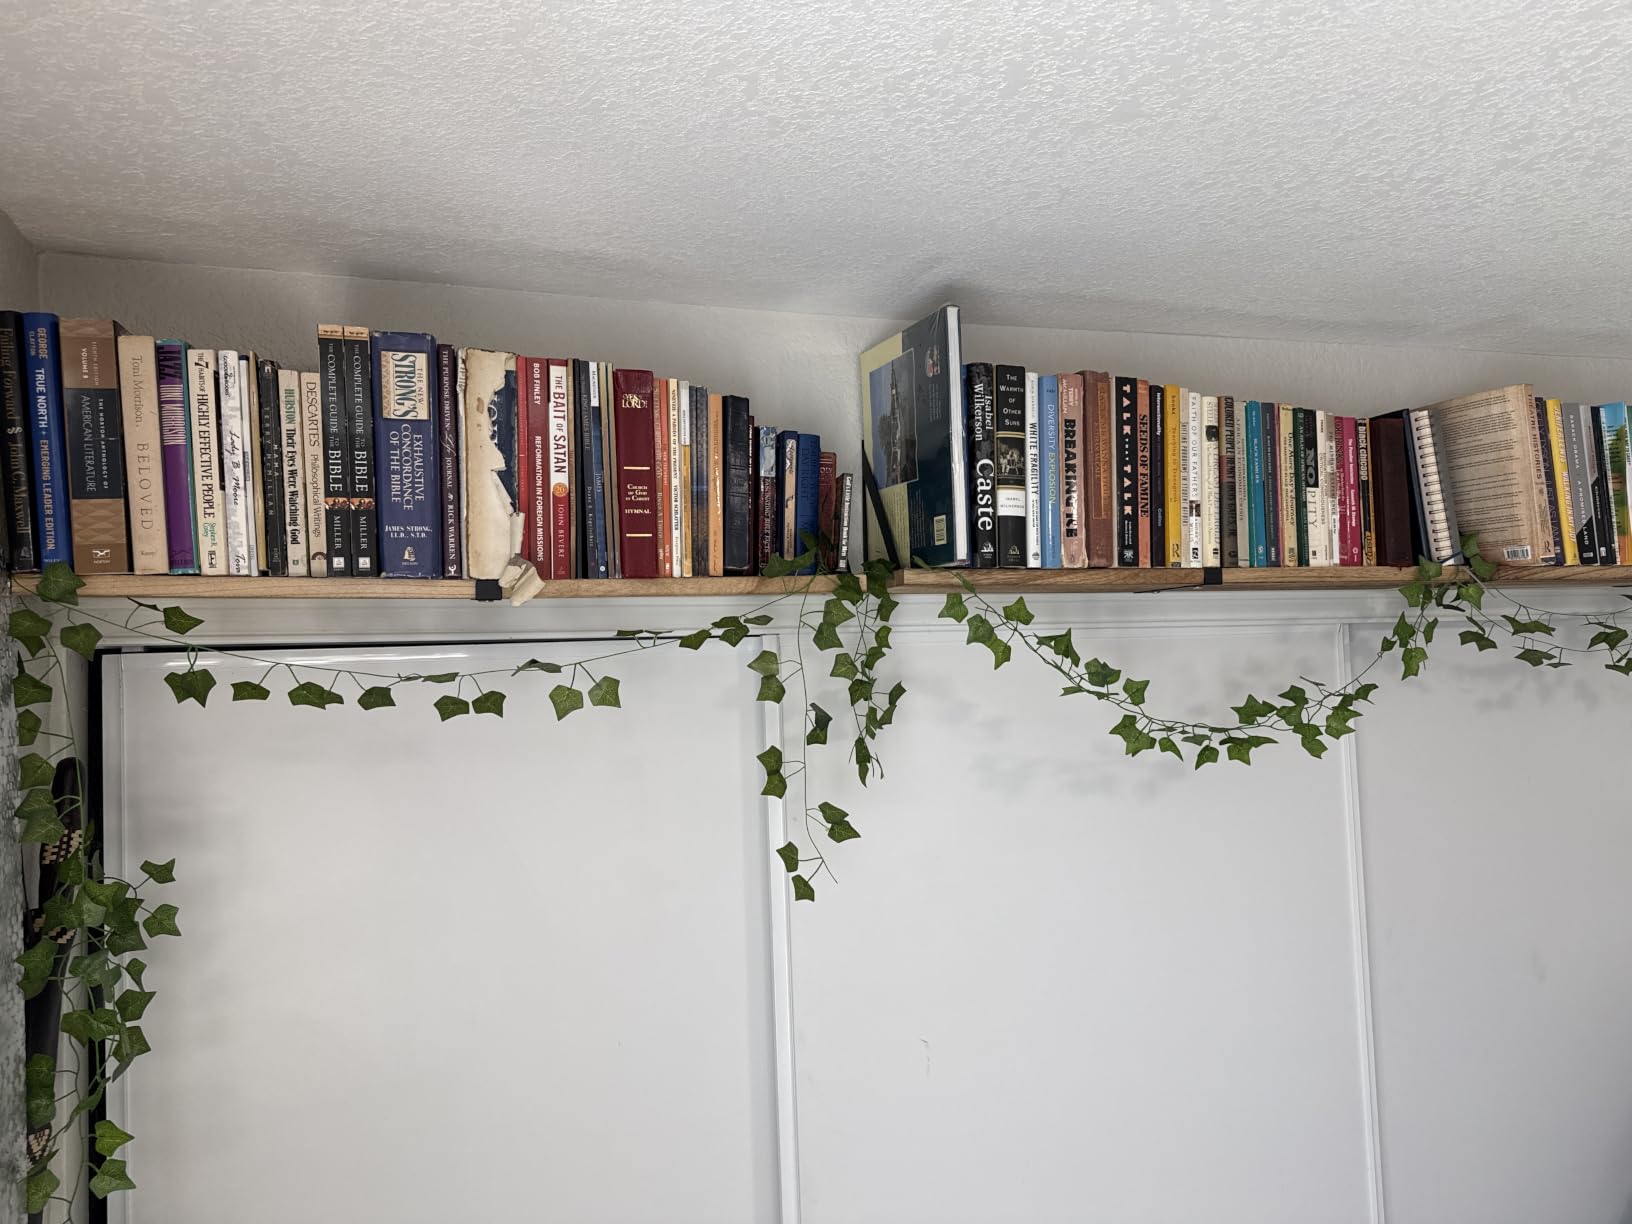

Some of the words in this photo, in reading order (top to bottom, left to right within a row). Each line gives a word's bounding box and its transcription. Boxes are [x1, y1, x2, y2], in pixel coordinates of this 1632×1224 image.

[0, 328, 15, 367] Failing
[37, 327, 48, 359] GEORGE
[35, 368, 46, 393] TRUE
[131, 356, 143, 374] Toni
[194, 361, 209, 369] 7
[198, 367, 206, 384] HABITS
[327, 354, 337, 402] COMPLETE
[353, 355, 363, 403] COMPLETE
[3, 370, 20, 420] Forward
[160, 384, 184, 401] TONI
[391, 353, 418, 418] STRONG'S
[533, 380, 541, 405] FINLEY
[37, 396, 48, 428] NORTH
[80, 395, 93, 441] AMERICAN
[197, 393, 211, 428] HIGHLY
[284, 388, 295, 425] HURSTON
[306, 381, 320, 447] DESCARTES
[328, 405, 338, 433] GUIDE
[355, 406, 365, 434] GUIDE
[553, 392, 566, 421] BAIT
[622, 399, 648, 408] LORD!
[974, 383, 984, 441] Wilkerson
[984, 395, 993, 429] Isabel
[1123, 384, 1131, 435] TALK
[1224, 397, 1233, 429] COLORED
[1528, 394, 1536, 430] THEATRE
[161, 404, 187, 445] MORRISON
[286, 427, 298, 449] Their
[389, 431, 399, 446] OF
[556, 424, 563, 432] OF
[1029, 422, 1037, 450] WHITE
[1048, 404, 1056, 450] DIVERSITY
[1140, 414, 1148, 452] SEEDS
[1192, 427, 1197, 436] OF
[1358, 426, 1366, 449] black
[1554, 406, 1562, 436] JENIFER
[1559, 437, 1567, 464] LEWIS
[8, 441, 25, 468] John
[198, 430, 215, 481] EFFECTIVE
[334, 438, 339, 446] TO
[360, 438, 365, 447] TO
[441, 430, 457, 457] Life
[554, 435, 567, 473] SATAN
[1225, 430, 1234, 455] PEOPLE
[1531, 434, 1542, 480] HISTORIES
[40, 439, 51, 481] EMERGING
[84, 444, 97, 492] LITERATURE
[101, 440, 109, 478] ANTHOLOGY
[286, 450, 298, 468] Eyes
[328, 450, 343, 491] BIBLE
[355, 451, 368, 492] BIBLE
[390, 449, 398, 471] THE
[401, 423, 413, 511] CONCORDANCE
[413, 434, 425, 501] EXHAUSTIVE
[445, 457, 453, 489] JOURNAL
[534, 436, 543, 487] REFORMATION
[1030, 453, 1039, 494] FRAGILITY
[1064, 418, 1077, 507] BREAKING
[1140, 454, 1148, 470] OF
[1226, 457, 1235, 479] HENRY
[1305, 448, 1315, 485] NO
[1360, 449, 1368, 480] chicago
[11, 470, 26, 485] C.
[103, 480, 109, 489] OF
[136, 443, 154, 530] BELOVED
[232, 476, 241, 506] Moore
[287, 469, 298, 489] Were
[310, 454, 321, 505] Philosophical
[391, 474, 401, 503] BIBLE
[535, 487, 542, 495] IN
[594, 473, 603, 493] JAMES
[976, 458, 995, 530] Caste
[1124, 464, 1132, 515] TALK
[1562, 472, 1571, 505] WALKING
[13, 486, 30, 534] Maxwell
[43, 483, 54, 515] LEADER
[201, 483, 215, 519] PEOPLE
[288, 490, 300, 527] Watching
[764, 478, 772, 516] FASCINATING
[1140, 472, 1149, 518] FAMINE
[1308, 489, 1317, 529] PITY
[1567, 506, 1573, 514] IN
[1578, 488, 1586, 524] PROMISED
[312, 506, 321, 538] Writings
[447, 505, 456, 524] RICK
[1066, 513, 1078, 538] ICE
[1568, 515, 1575, 528] MY
[45, 518, 55, 550] EDITION
[289, 528, 301, 545] God
[333, 516, 342, 549] MILLER
[359, 516, 368, 549] MILLER
[447, 526, 457, 560] WARREN
[536, 528, 544, 562] MISSIONS
[1569, 529, 1577, 543] JOY
